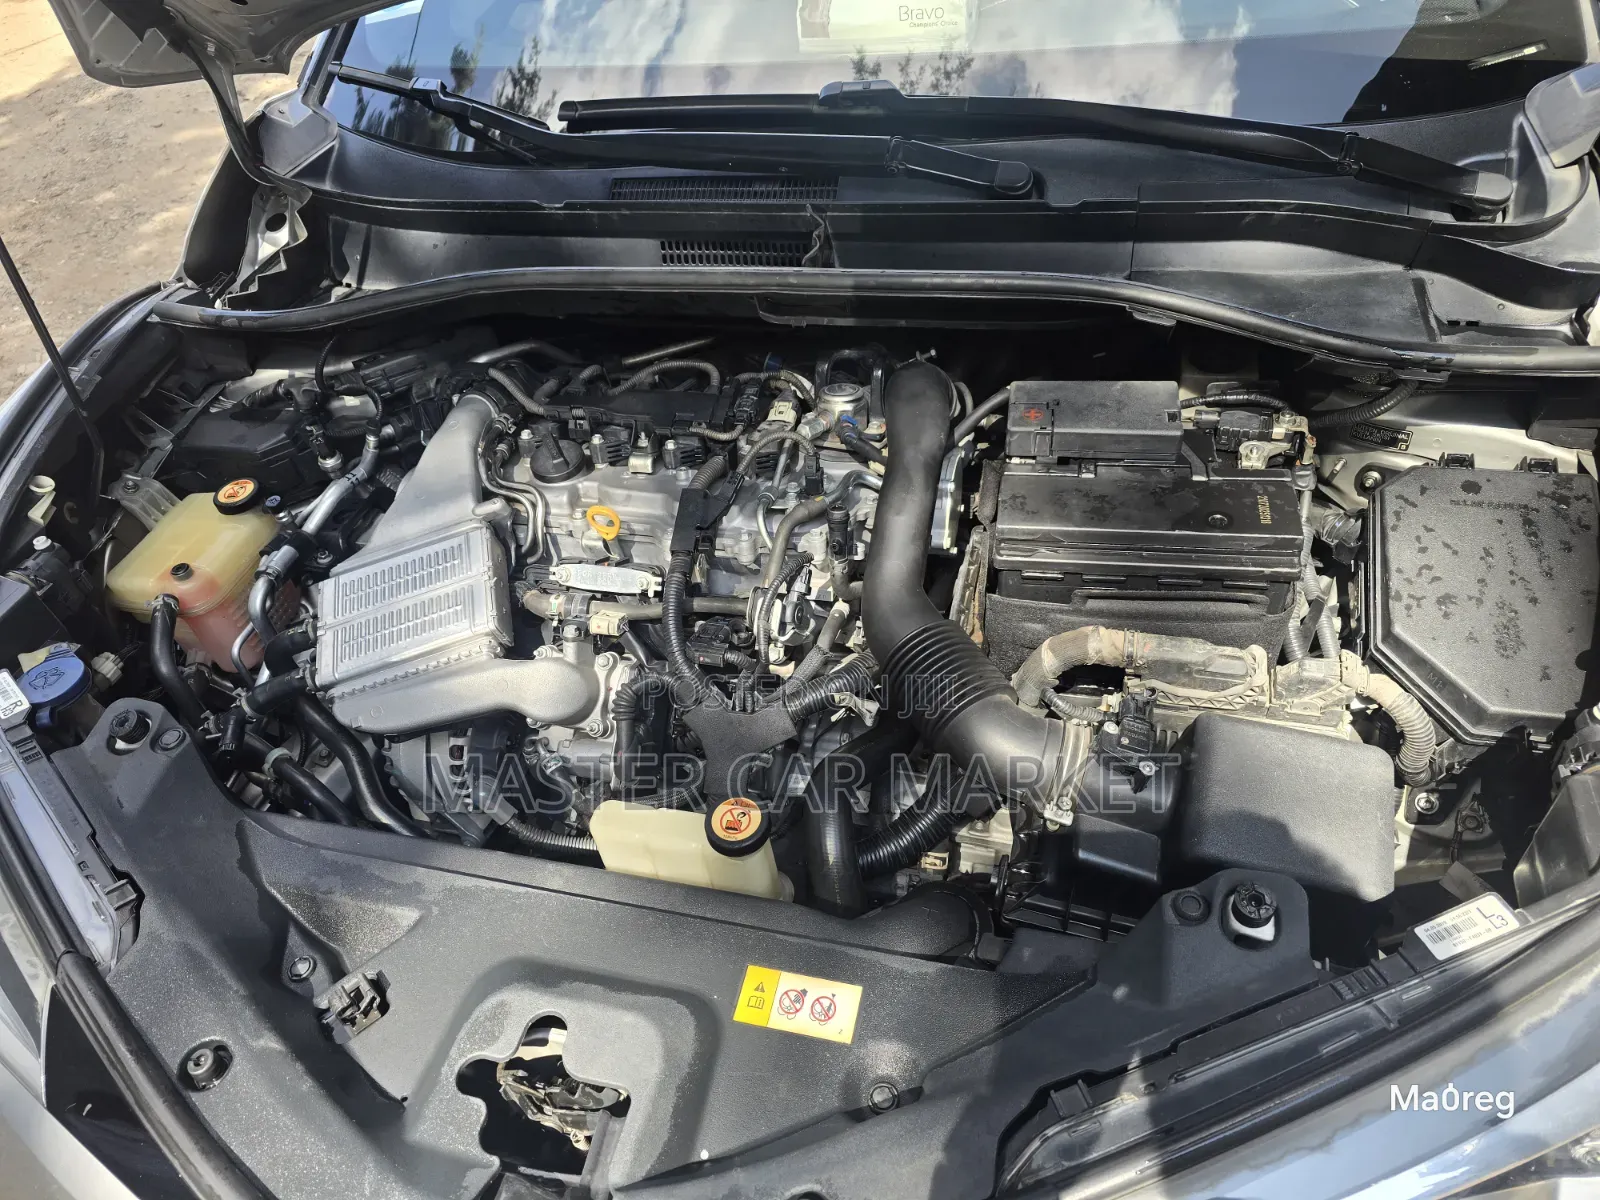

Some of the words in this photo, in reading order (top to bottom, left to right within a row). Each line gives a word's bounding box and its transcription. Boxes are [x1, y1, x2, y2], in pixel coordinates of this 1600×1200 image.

[898, 5, 945, 21] Bravo
[10, 699, 23, 711] R
[1476, 906, 1495, 920] L
[1489, 914, 1509, 930] L3
